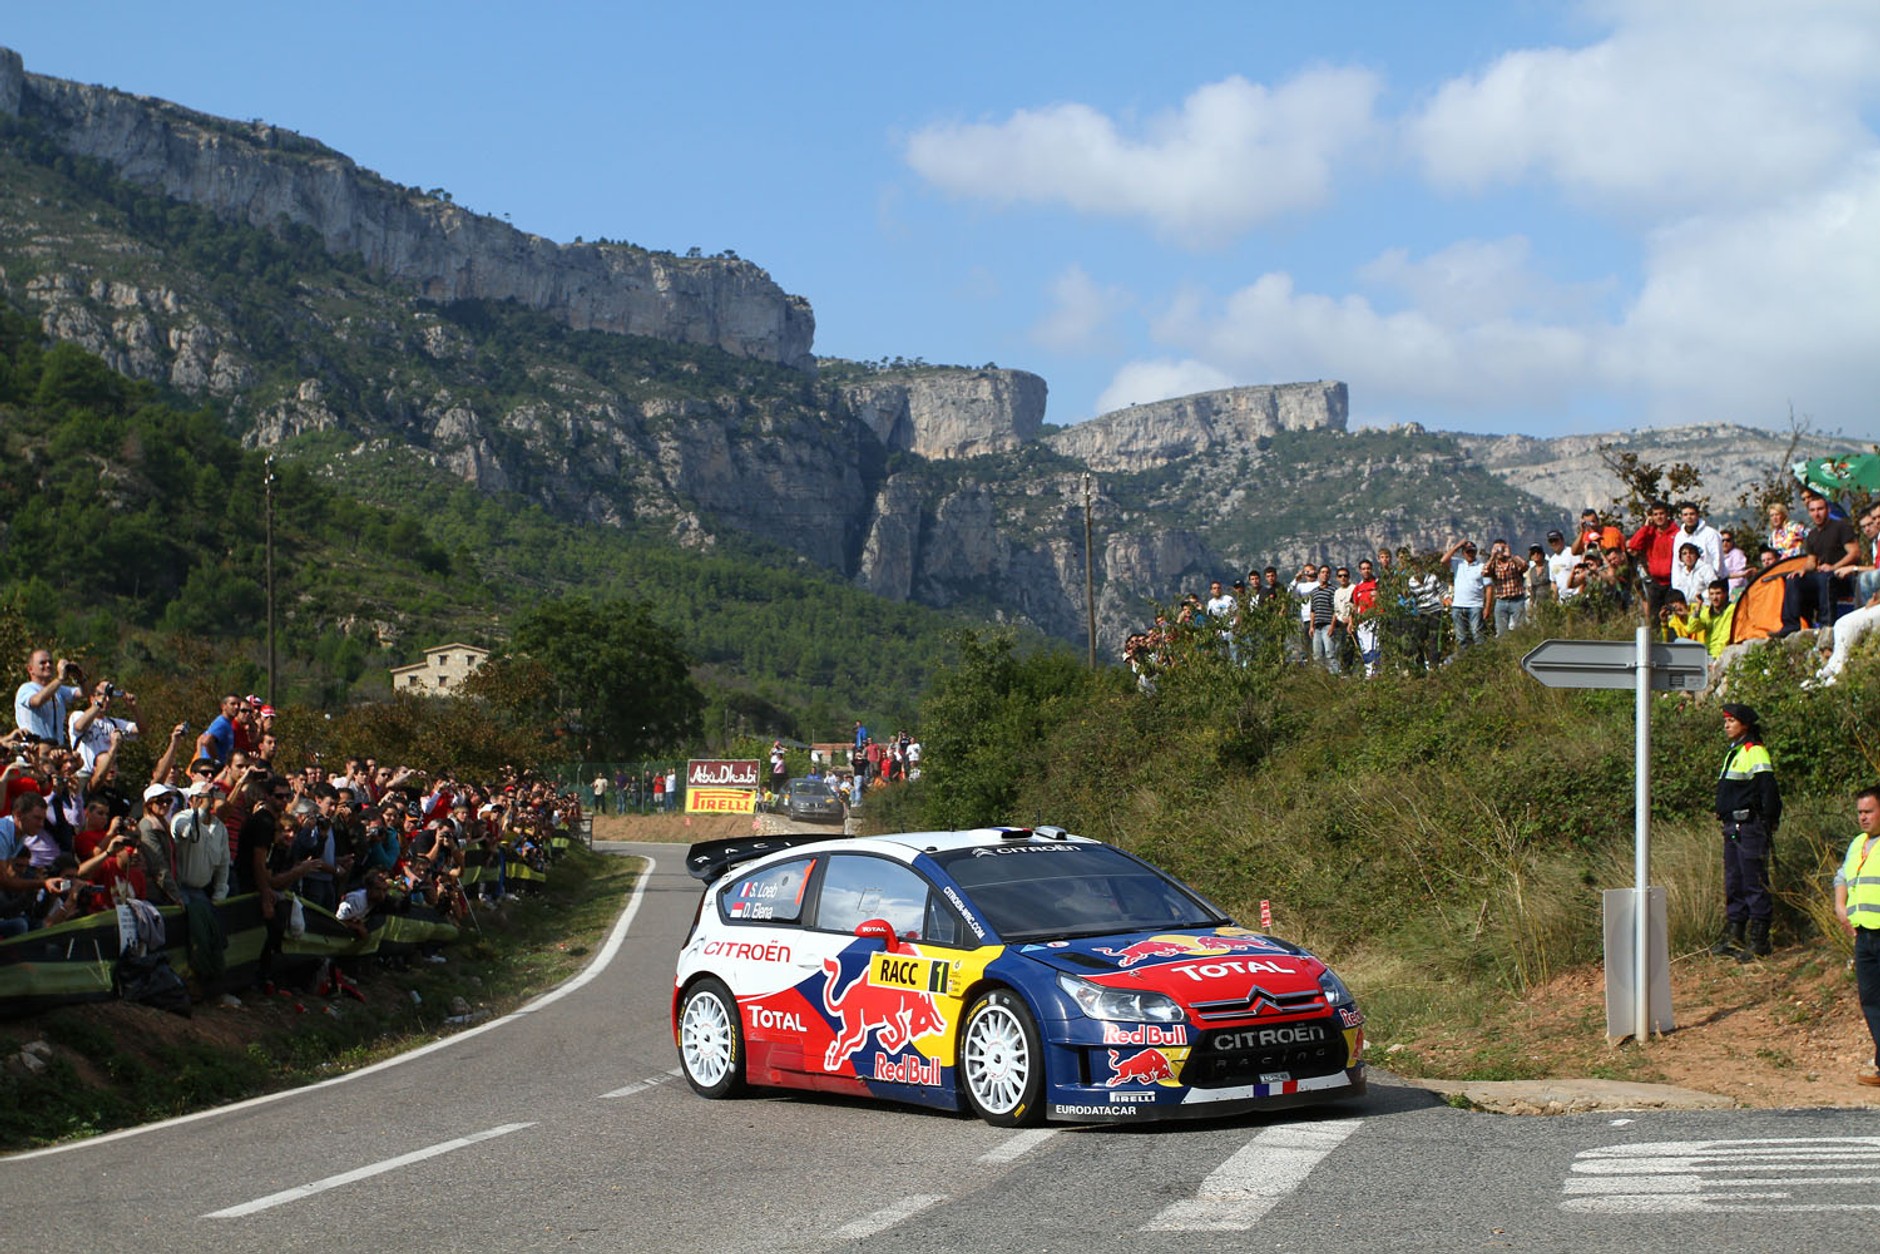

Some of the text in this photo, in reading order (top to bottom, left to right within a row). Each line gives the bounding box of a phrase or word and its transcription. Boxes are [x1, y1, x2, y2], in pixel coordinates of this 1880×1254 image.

[690, 765, 758, 784] Abu Dhabi
[692, 791, 750, 811] PIRELLI
[749, 882, 778, 898] S. Loeb
[742, 902, 774, 919] D. Elena
[880, 959, 919, 985] RACC
[936, 962, 946, 992] 1
[1171, 961, 1296, 981] TOTAL
[747, 1005, 808, 1032] TOTAL
[1103, 1023, 1187, 1045] Red Bull
[874, 1051, 942, 1086] Red Bull
[1109, 1091, 1155, 1102] PIRELLI
[1056, 1105, 1136, 1115] EURODATACAR
